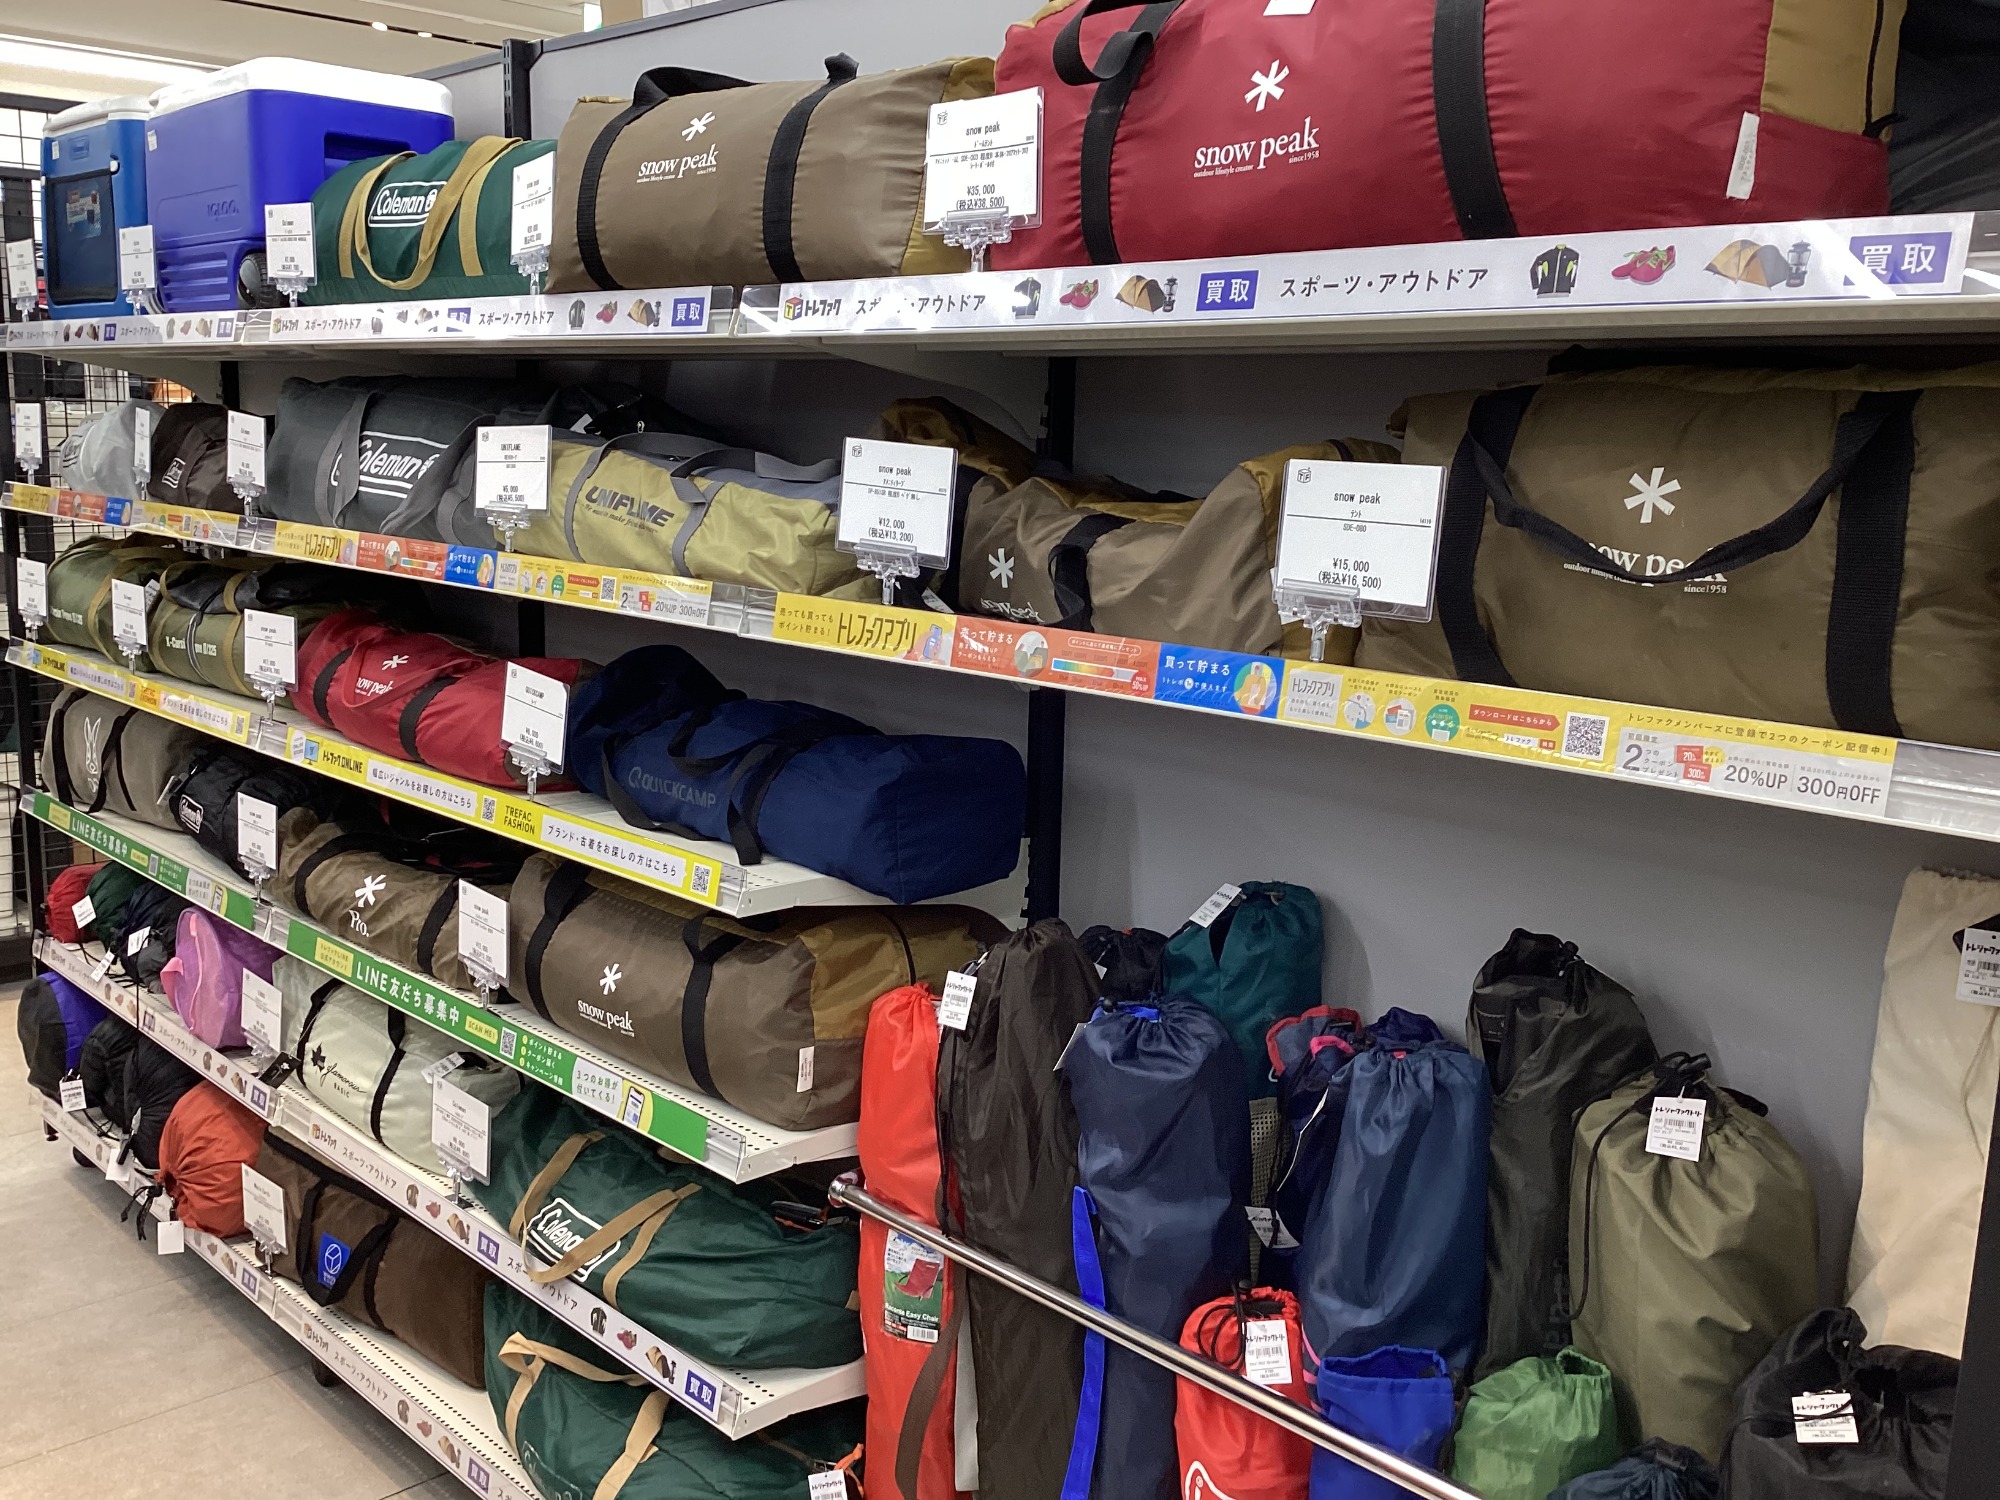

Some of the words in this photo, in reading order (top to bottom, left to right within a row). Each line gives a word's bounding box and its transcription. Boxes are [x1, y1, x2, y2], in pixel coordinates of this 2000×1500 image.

[966, 126, 982, 136] snow
[984, 121, 1000, 135] peak
[1194, 141, 1256, 168] snow
[1257, 116, 1319, 170] peak
[638, 158, 681, 177] snow
[677, 144, 719, 178] peak
[967, 184, 996, 196] ¥35,000
[376, 190, 426, 215] Coleman
[956, 196, 1004, 210] (税込¥38,500)
[1280, 267, 1490, 299] スポーツ・アウトドア
[1861, 240, 1935, 278] 買取
[804, 298, 842, 317] トレファク
[1205, 276, 1250, 306] 買取
[479, 310, 554, 326] スポーツ・アウトドア
[676, 302, 700, 322] 買取
[878, 466, 894, 474] snow
[896, 466, 912, 476] peak
[1334, 492, 1355, 503] snow
[1359, 492, 1382, 505] peak
[878, 516, 905, 530] ¥12,000
[1350, 510, 1362, 518] テント
[868, 526, 914, 543] (税込¥13,200)
[1332, 558, 1370, 573] ¥15,000
[1318, 570, 1382, 590] (税込¥16,500)
[1684, 584, 1728, 594] since1958
[621, 592, 628, 608] 2
[655, 600, 676, 614] 20%UP
[679, 604, 707, 619] 300円OFF
[779, 608, 834, 624] 売っても買っても
[778, 621, 831, 636] ポイント貯まる!
[837, 612, 918, 654] トレファクアプリ
[960, 626, 1013, 644] 売って貯まる
[1164, 656, 1230, 676] 買って貯まる
[1292, 678, 1335, 698] トレファクアプリ
[1473, 708, 1552, 726] ダウンロードはこちらから
[1628, 712, 1890, 757] トレファクメンバーズに登録で2つのクーポン配信中!
[1622, 744, 1643, 772] 2
[1644, 758, 1674, 768] クーポン
[1646, 749, 1660, 757] つの
[1643, 768, 1678, 778] プレゼント
[1724, 764, 1788, 790] 20%UP
[372, 767, 472, 809] 幅広いジャンルをお探しの方はこちら
[642, 776, 716, 808] QUICKCAMP
[1797, 776, 1882, 804] 300円OFF
[506, 804, 532, 822] TREFAC
[504, 816, 535, 836] FASHION
[548, 824, 677, 877] ブランド・古着をお探しの方はこちら
[348, 909, 370, 938] Pro.
[356, 960, 460, 1027] LINE友だち募集中
[578, 1000, 604, 1021] snow
[606, 1010, 634, 1030] peak
[468, 1020, 484, 1033] SCAN
[484, 1026, 496, 1040] ME!
[529, 1038, 562, 1060] ポイント貯まる
[576, 1070, 618, 1090] 3つのお得が
[576, 1084, 615, 1104] 付いてくる!
[1655, 1106, 1702, 1117] トレジャーファクトリー
[320, 1130, 337, 1150] トレファク
[342, 1146, 396, 1188] スポーツ・アウトドア
[480, 1237, 498, 1259] 買取
[688, 1376, 712, 1406] 買取
[906, 1310, 922, 1320] Easy
[922, 1314, 940, 1323] Chair
[334, 1351, 388, 1401] スポーツ・アウトドア
